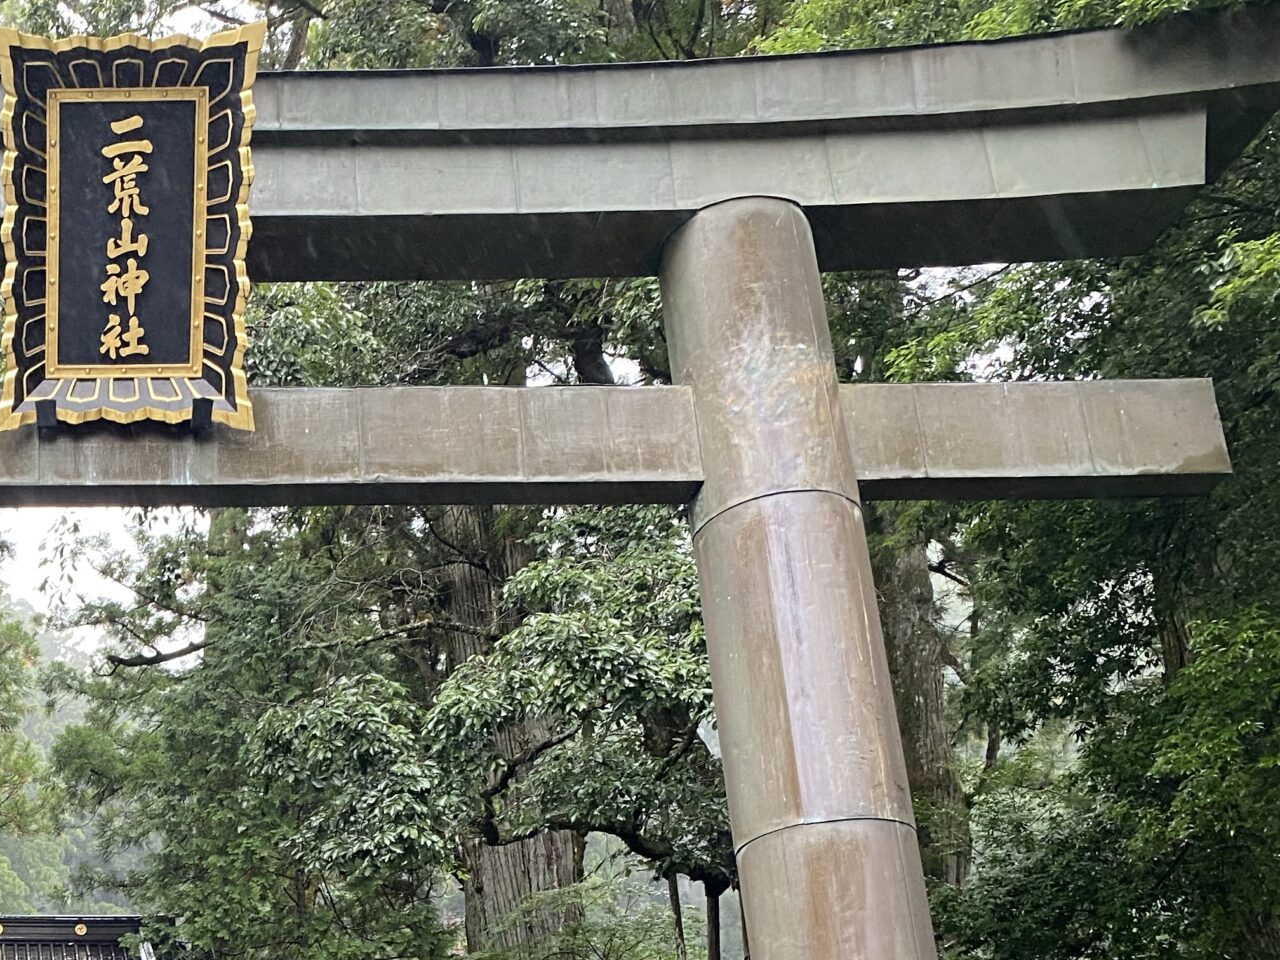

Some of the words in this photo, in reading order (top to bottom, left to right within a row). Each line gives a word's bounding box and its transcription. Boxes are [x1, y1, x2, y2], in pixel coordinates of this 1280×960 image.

[99, 115, 154, 360] 二荒山神社
